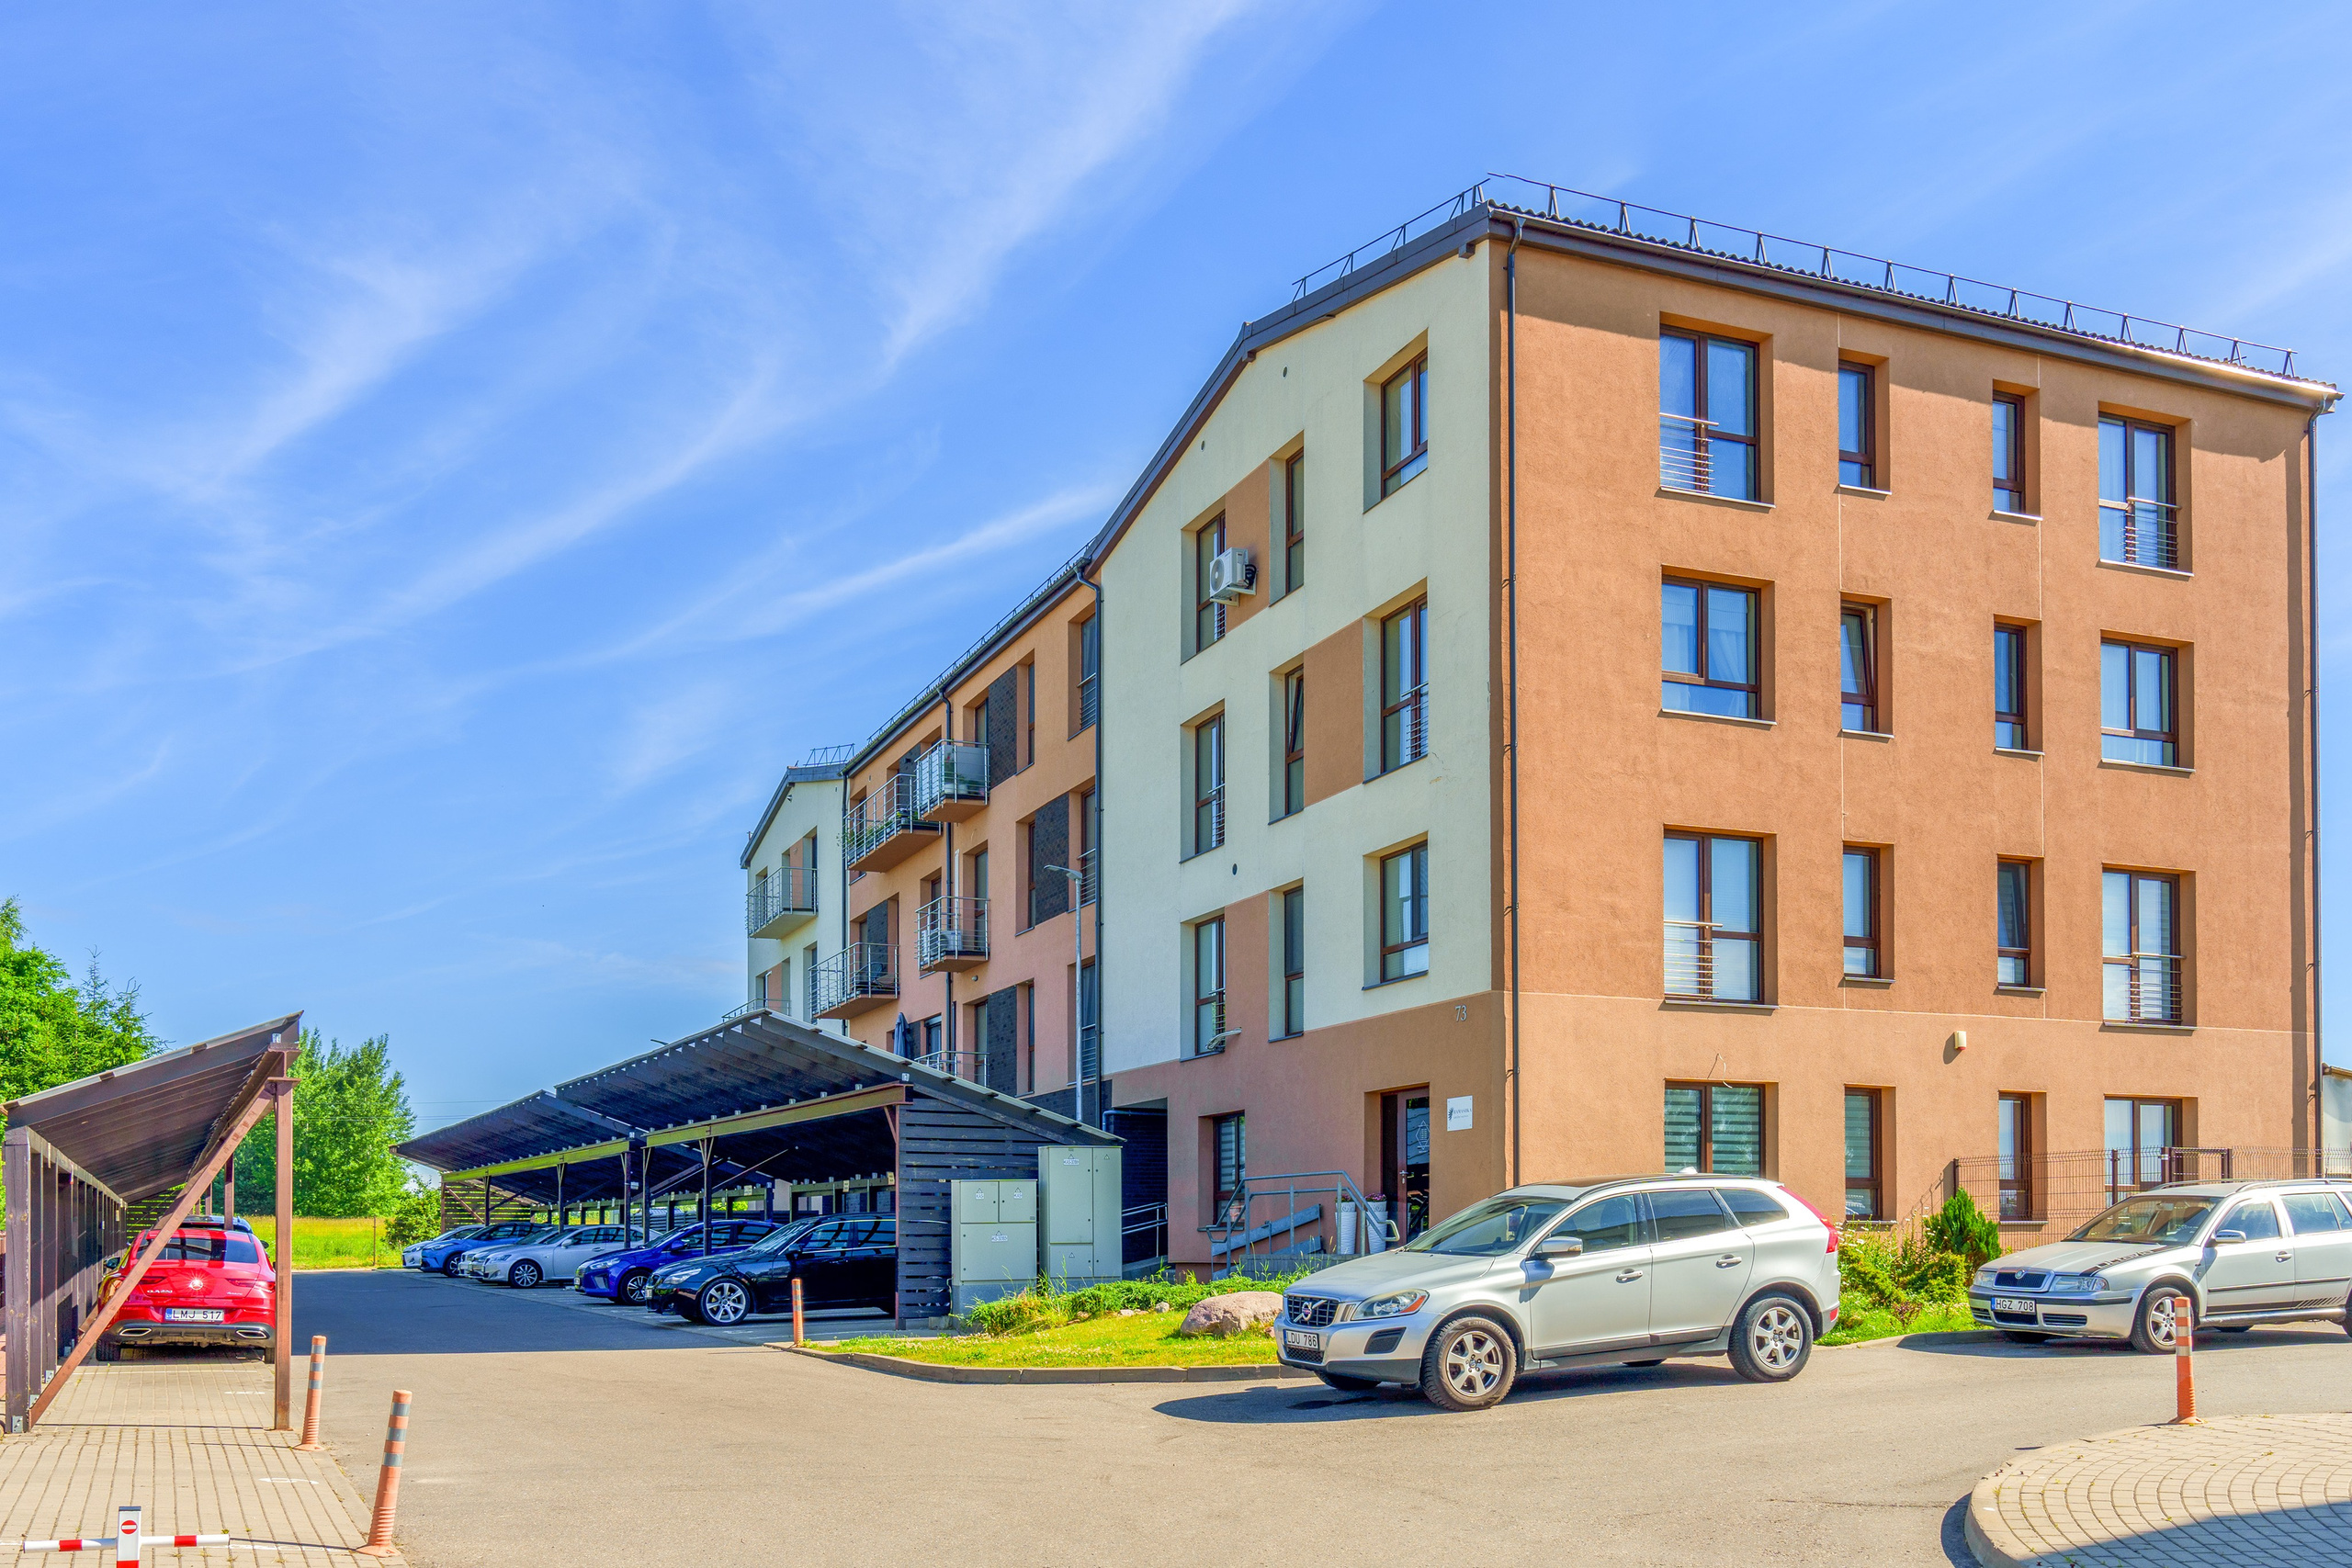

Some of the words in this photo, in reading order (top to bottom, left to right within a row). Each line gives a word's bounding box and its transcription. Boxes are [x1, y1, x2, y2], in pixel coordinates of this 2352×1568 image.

[1454, 1005, 1467, 1021] 73
[1996, 1299, 2013, 1310] HGZ
[2018, 1301, 2034, 1312] 708
[172, 1309, 196, 1319] LMJ
[202, 1311, 222, 1320] 517
[1286, 1331, 1300, 1345] LDU
[1304, 1334, 1317, 1348] 786
